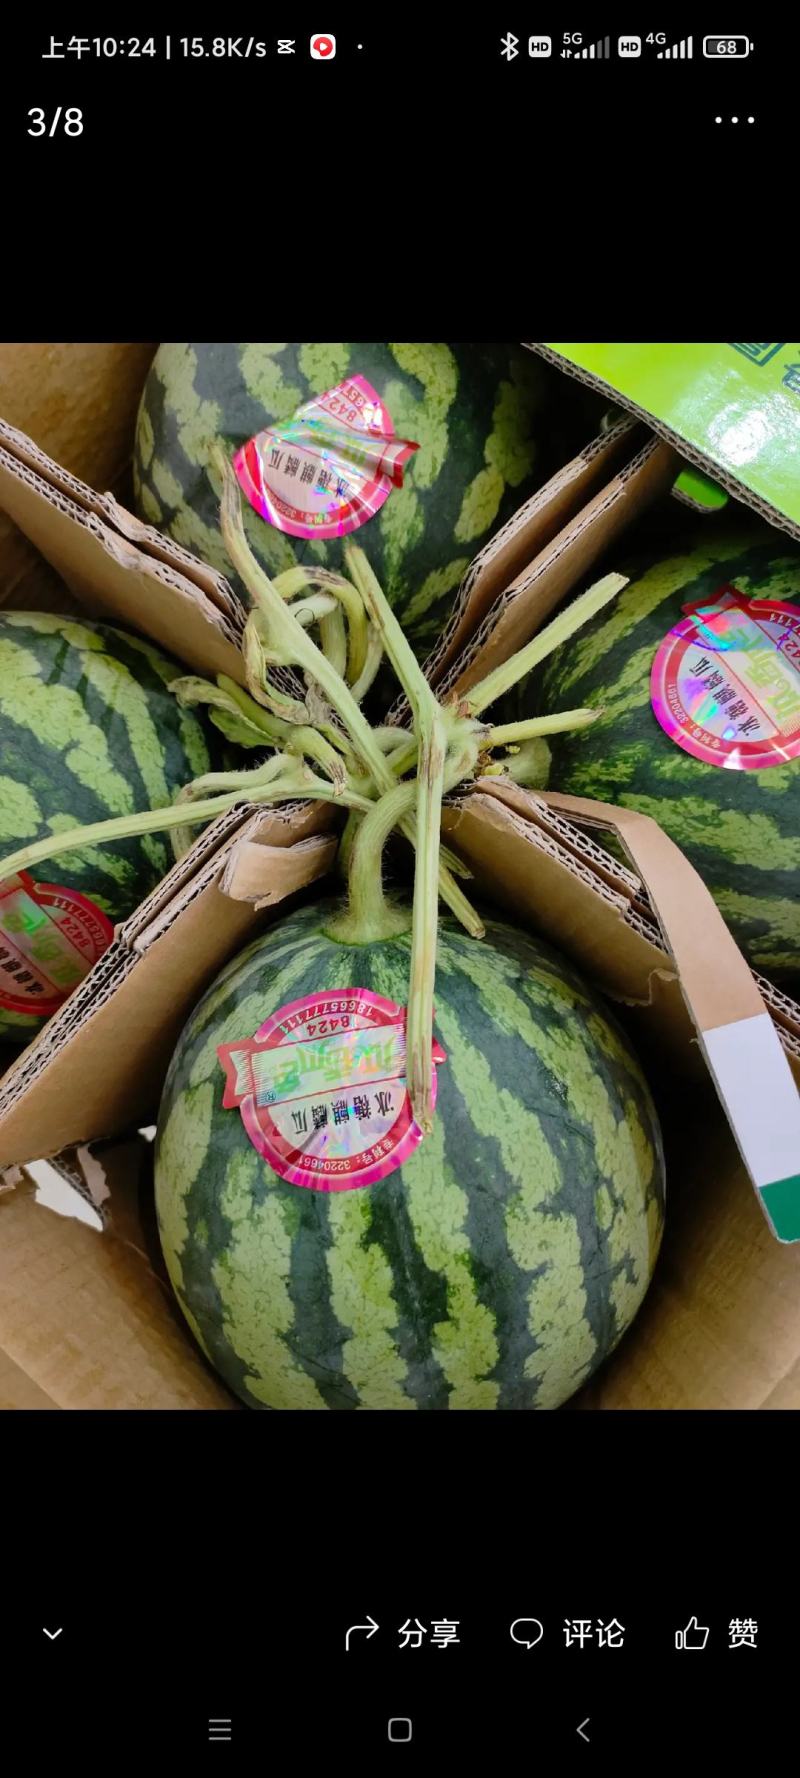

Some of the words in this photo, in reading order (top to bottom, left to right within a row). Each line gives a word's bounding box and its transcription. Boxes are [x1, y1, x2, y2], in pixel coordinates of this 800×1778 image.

[61, 916, 90, 948] 8424
[306, 1015, 351, 1037] 8424
[290, 1091, 395, 1134] 冰糖麒麟瓜
